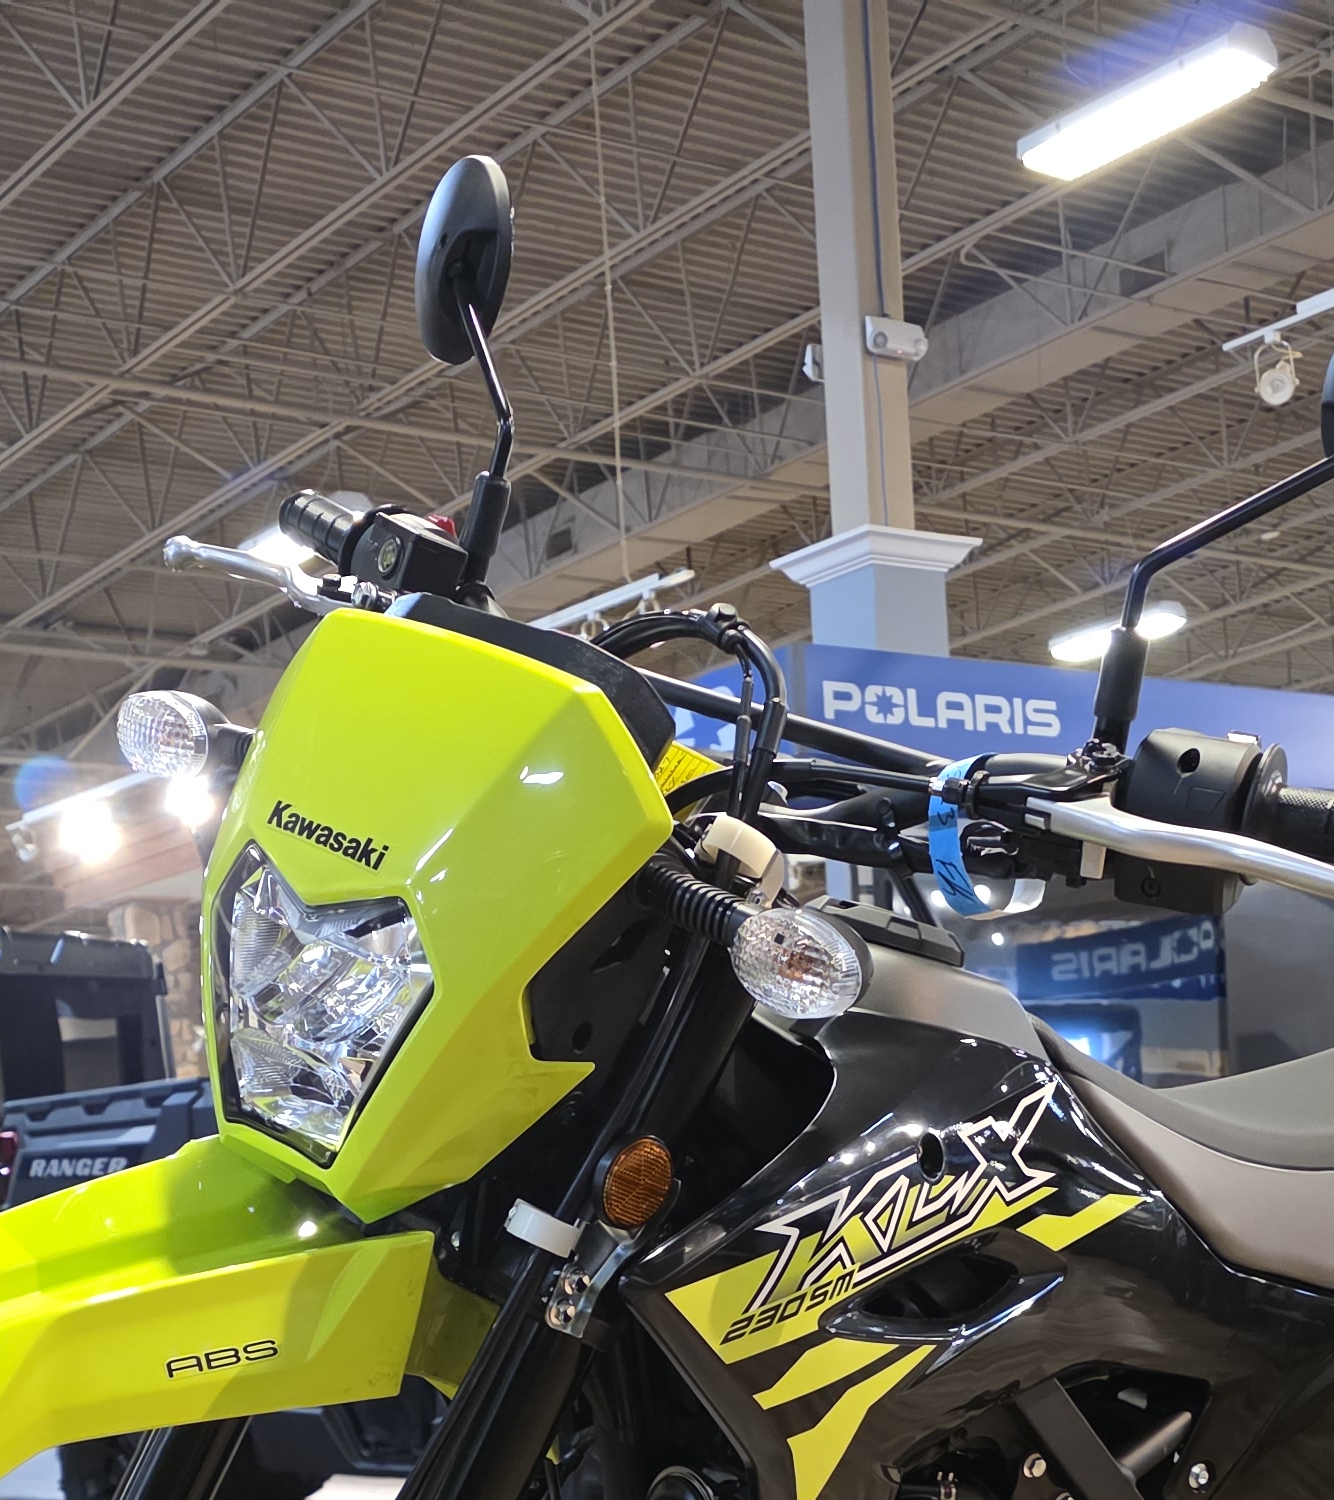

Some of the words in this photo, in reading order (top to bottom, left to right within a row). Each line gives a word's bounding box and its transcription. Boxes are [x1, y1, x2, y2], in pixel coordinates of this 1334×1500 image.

[822, 680, 1062, 737] POLARIS
[267, 800, 389, 870] Kawasaki
[29, 1157, 127, 1178] RANGER
[166, 1340, 278, 1378] ABS
